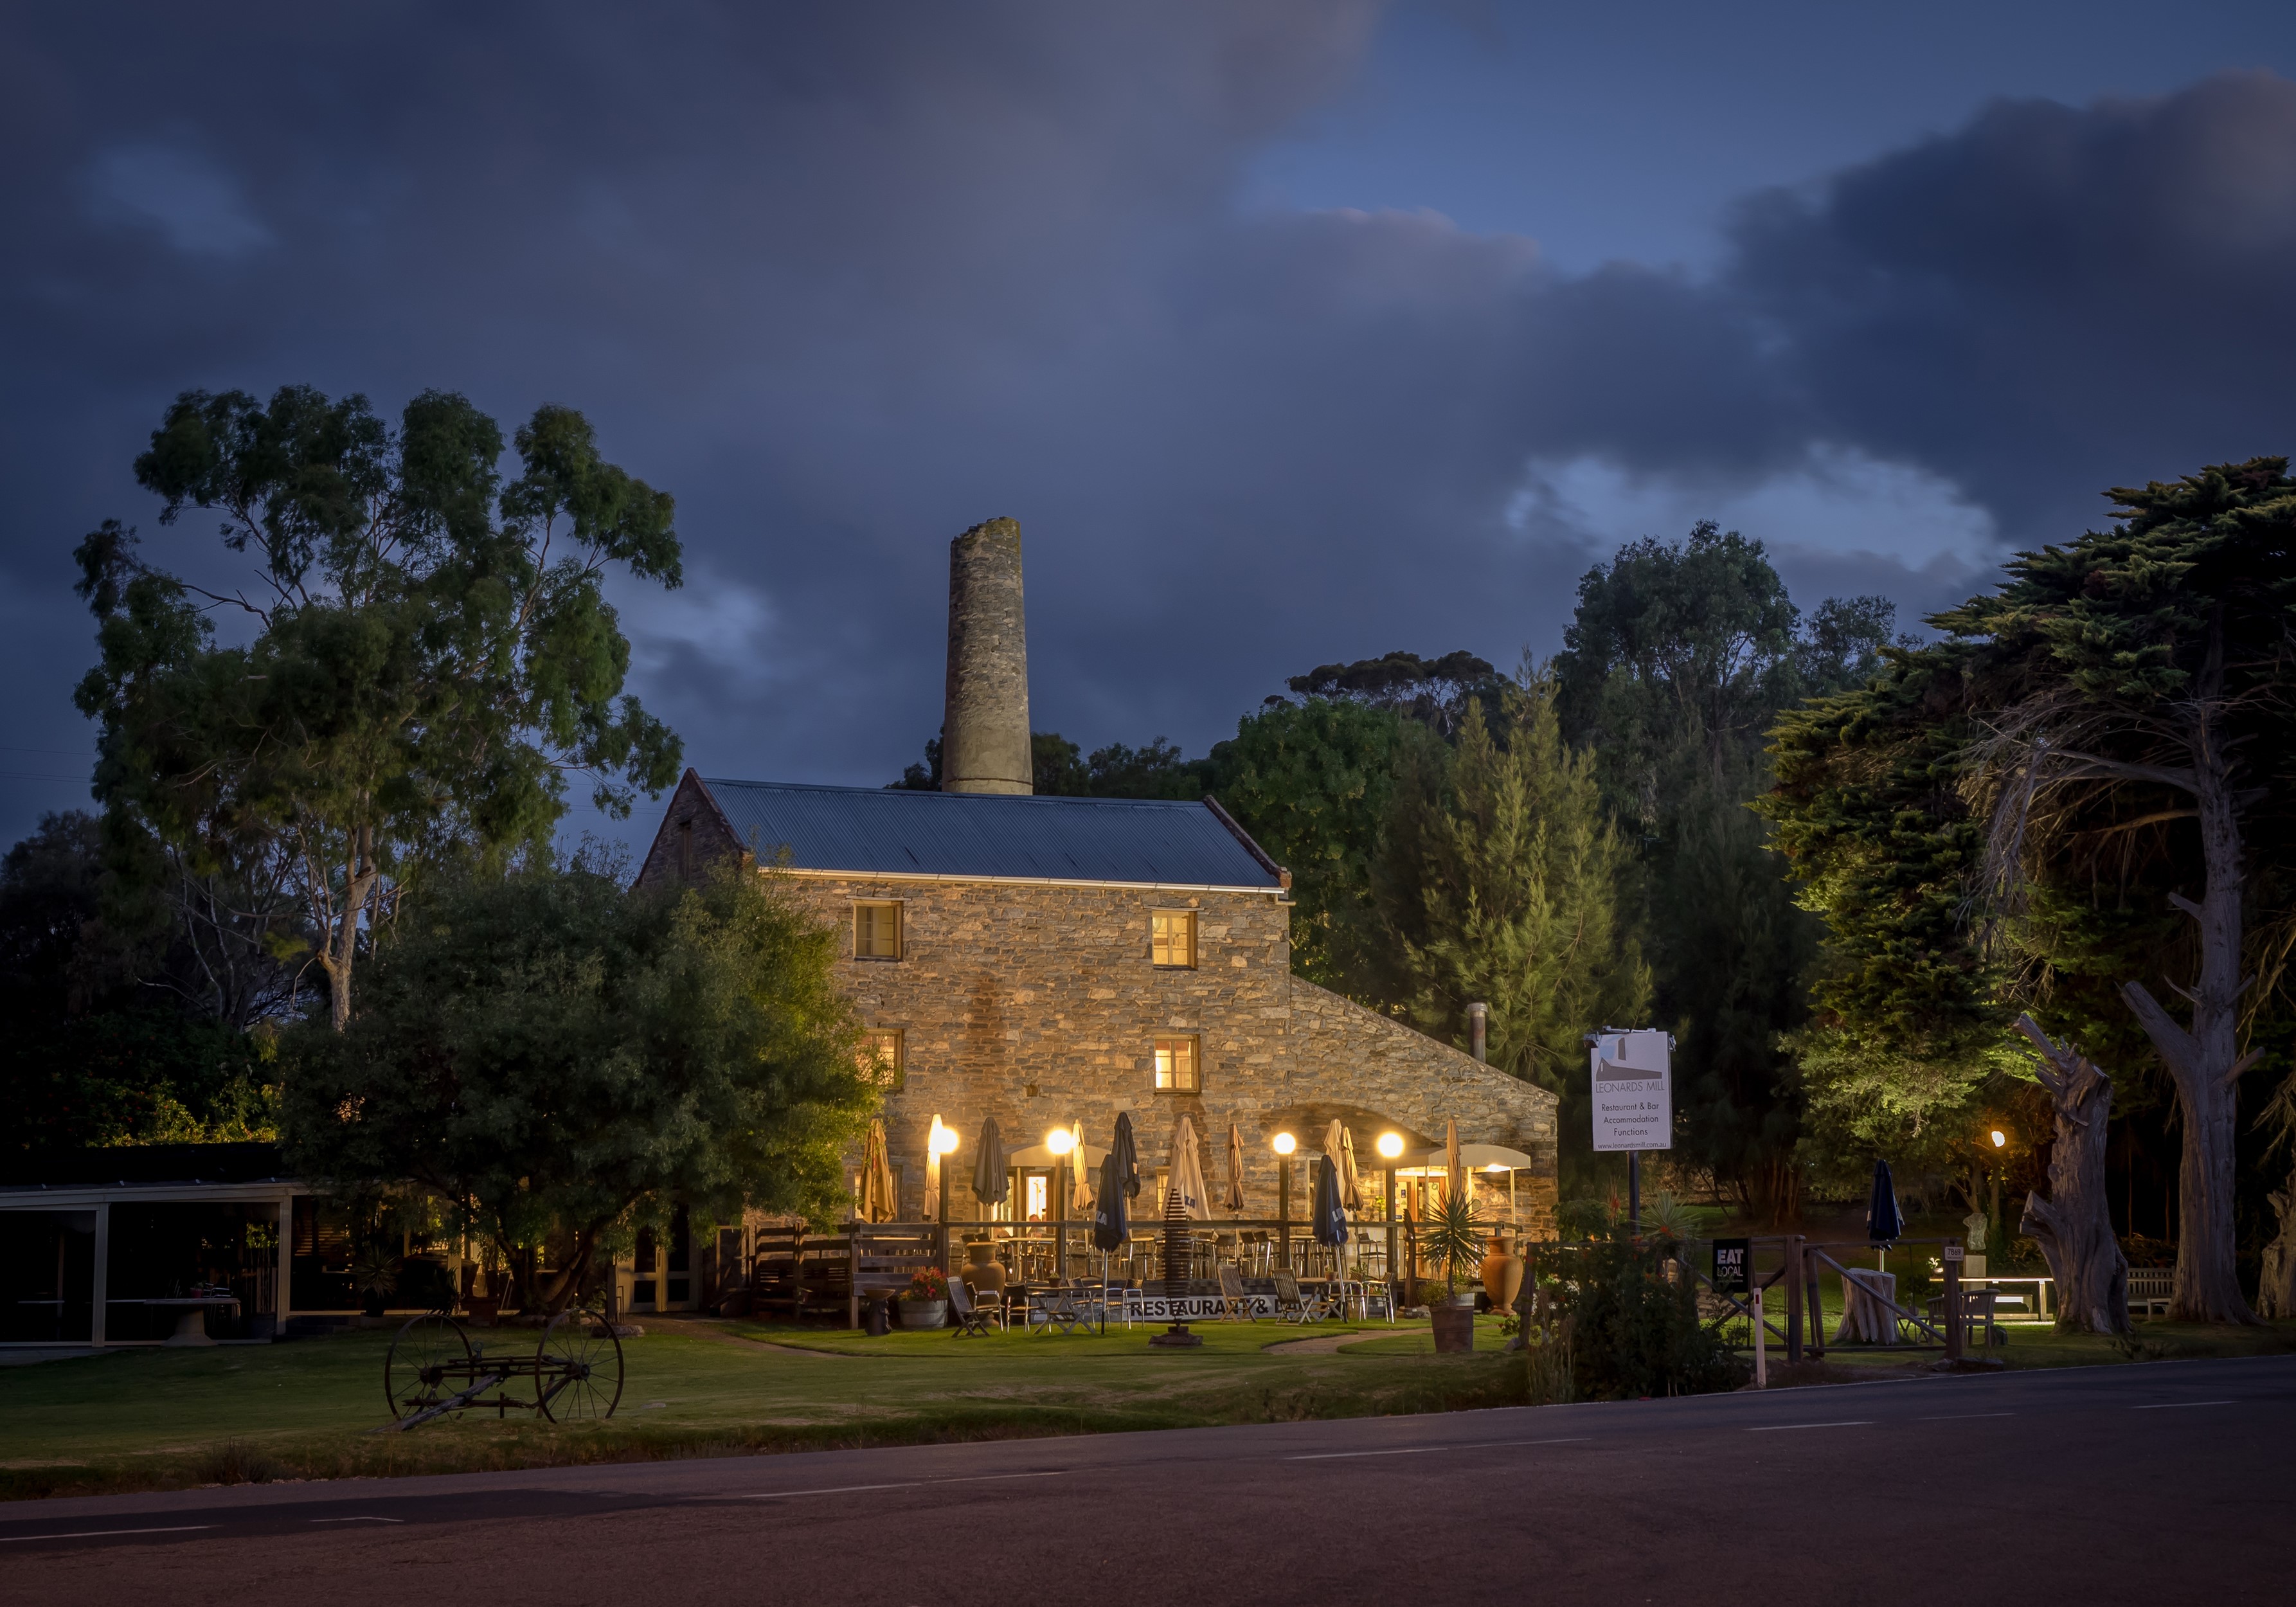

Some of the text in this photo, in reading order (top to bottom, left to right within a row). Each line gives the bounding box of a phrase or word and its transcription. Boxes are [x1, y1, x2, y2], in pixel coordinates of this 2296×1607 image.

[1596, 1081, 1665, 1093] LEONARDS MILL
[1647, 1102, 1659, 1110] Bar
[1603, 1114, 1659, 1124] Accommodation
[1613, 1127, 1648, 1136] Functions
[1718, 1249, 1743, 1264] EAT
[1717, 1266, 1743, 1277] LOCAL
[1255, 1299, 1269, 1314] &
